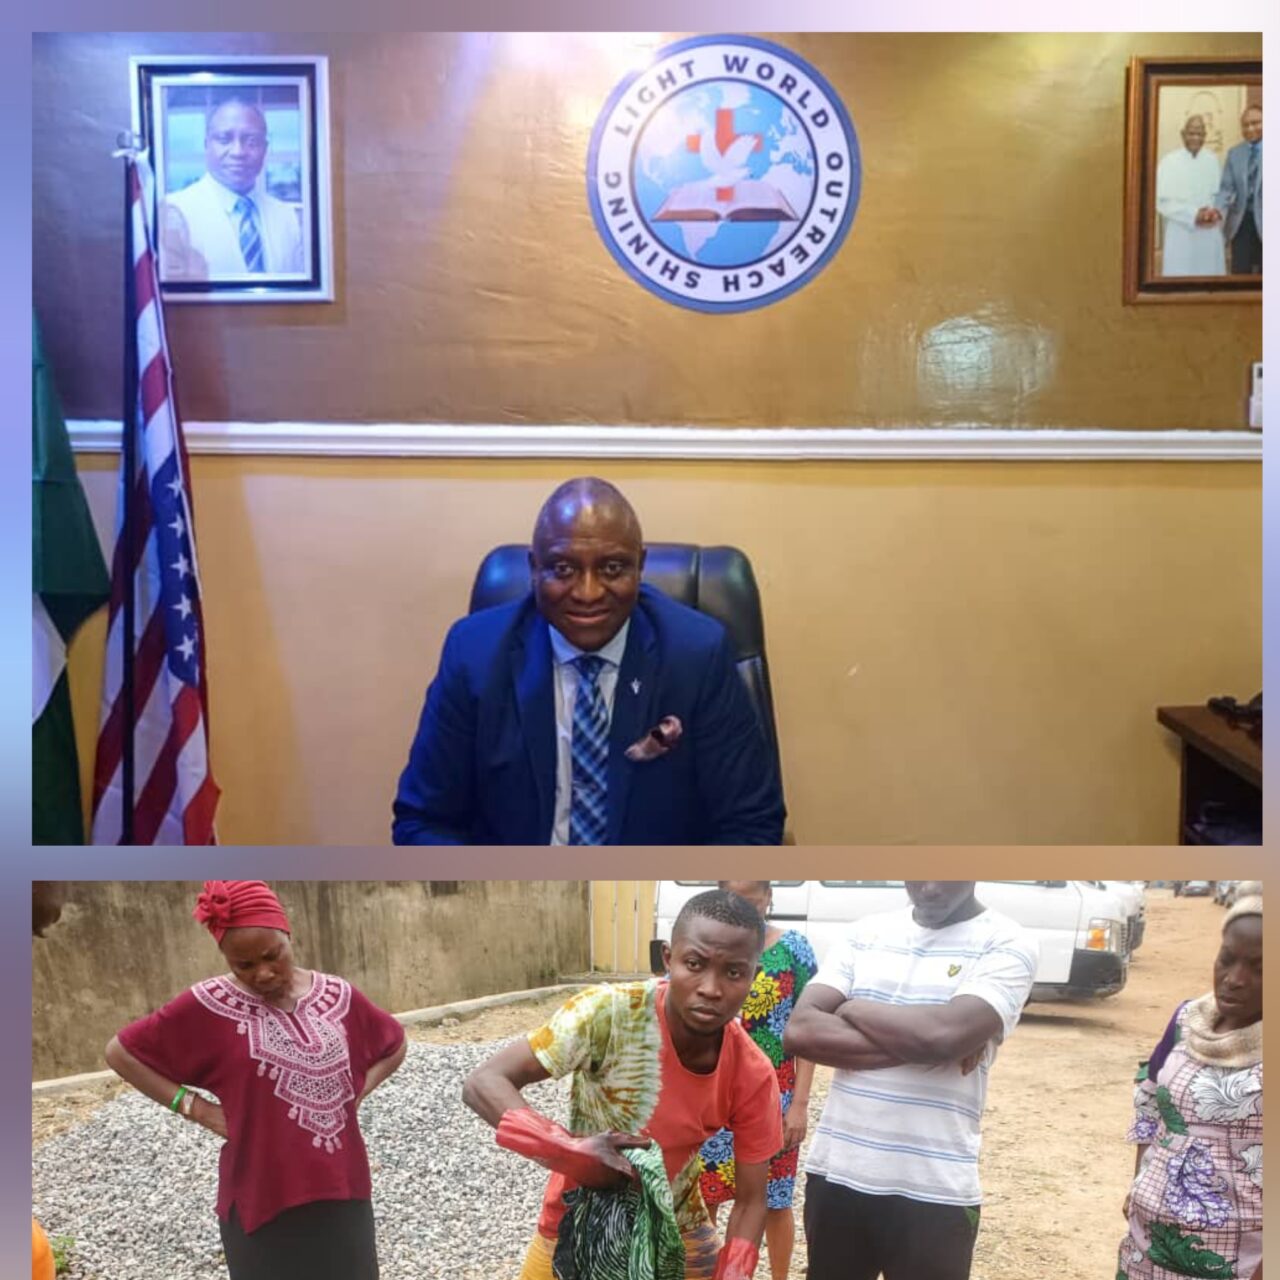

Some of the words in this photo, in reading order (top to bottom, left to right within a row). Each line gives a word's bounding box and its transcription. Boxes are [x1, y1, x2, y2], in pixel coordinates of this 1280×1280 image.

[614, 60, 696, 138] LIGHT
[722, 54, 830, 129] WORLD
[605, 171, 702, 290] SHINING
[722, 152, 844, 293] OUTREACH
